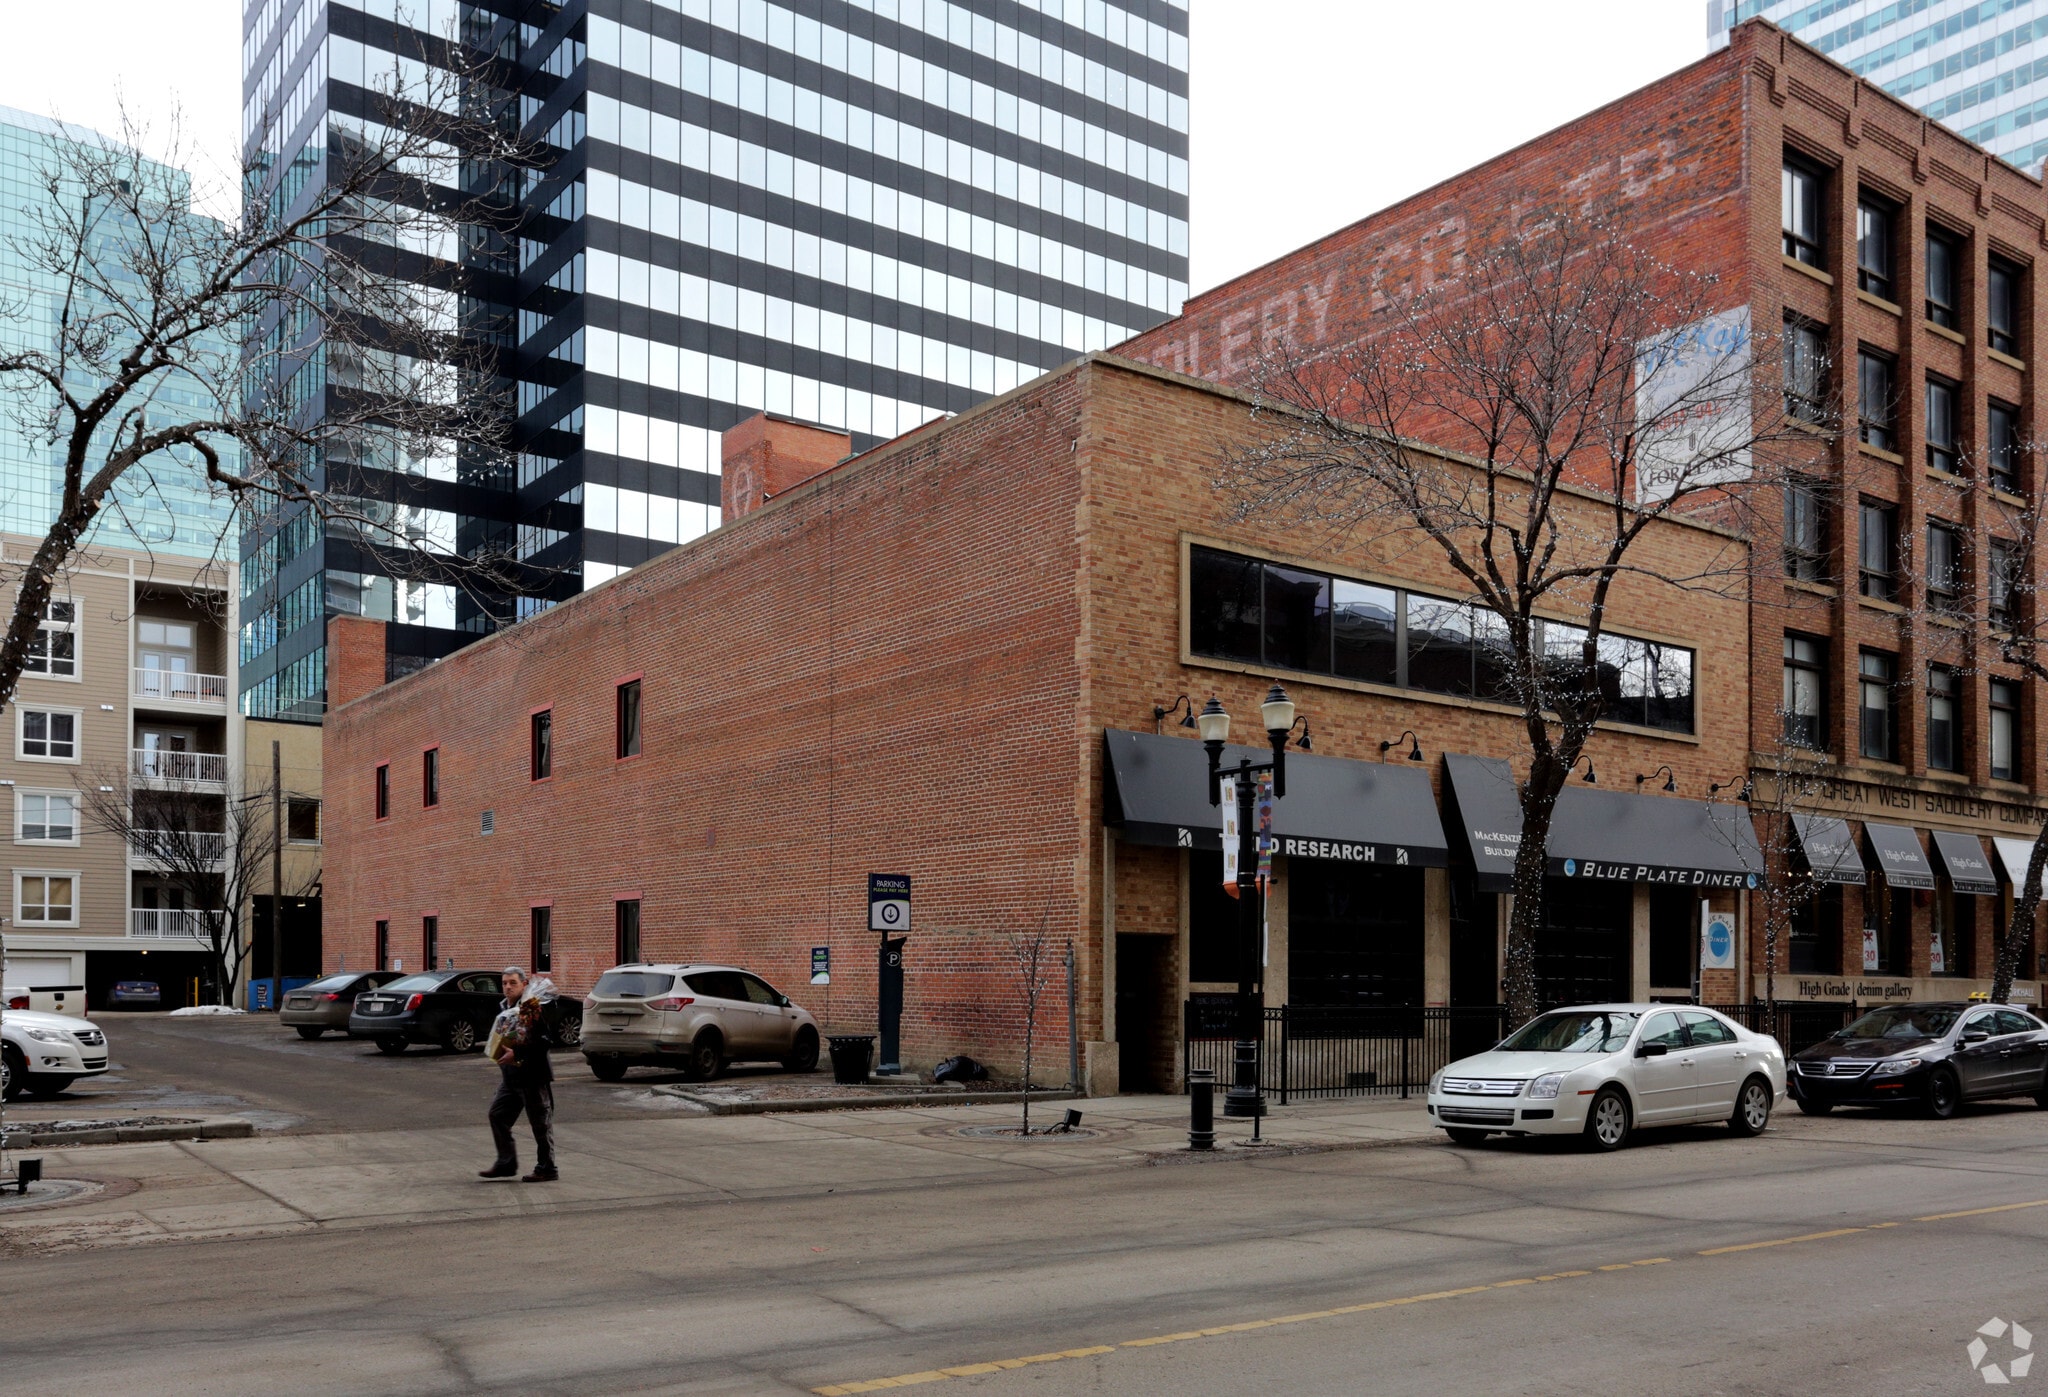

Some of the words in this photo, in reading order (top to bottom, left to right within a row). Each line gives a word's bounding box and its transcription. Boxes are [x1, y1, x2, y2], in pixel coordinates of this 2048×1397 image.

[1822, 781, 1872, 804] GREAT
[1878, 785, 1919, 810] WEST
[1925, 793, 1994, 820] SADDLERY
[2000, 805, 2048, 826] COMPAN
[1285, 839, 1375, 862] RESEARCH
[1484, 846, 1518, 857] BUILDIN
[876, 880, 906, 889] PARKING
[1582, 862, 1629, 880] BLUE
[1634, 866, 1688, 884] PLATE
[1692, 871, 1743, 887] DINER
[1799, 981, 1822, 999] High
[1824, 982, 1850, 997] Grade
[1857, 982, 1883, 997] denim
[1885, 982, 1913, 1000] gallery
